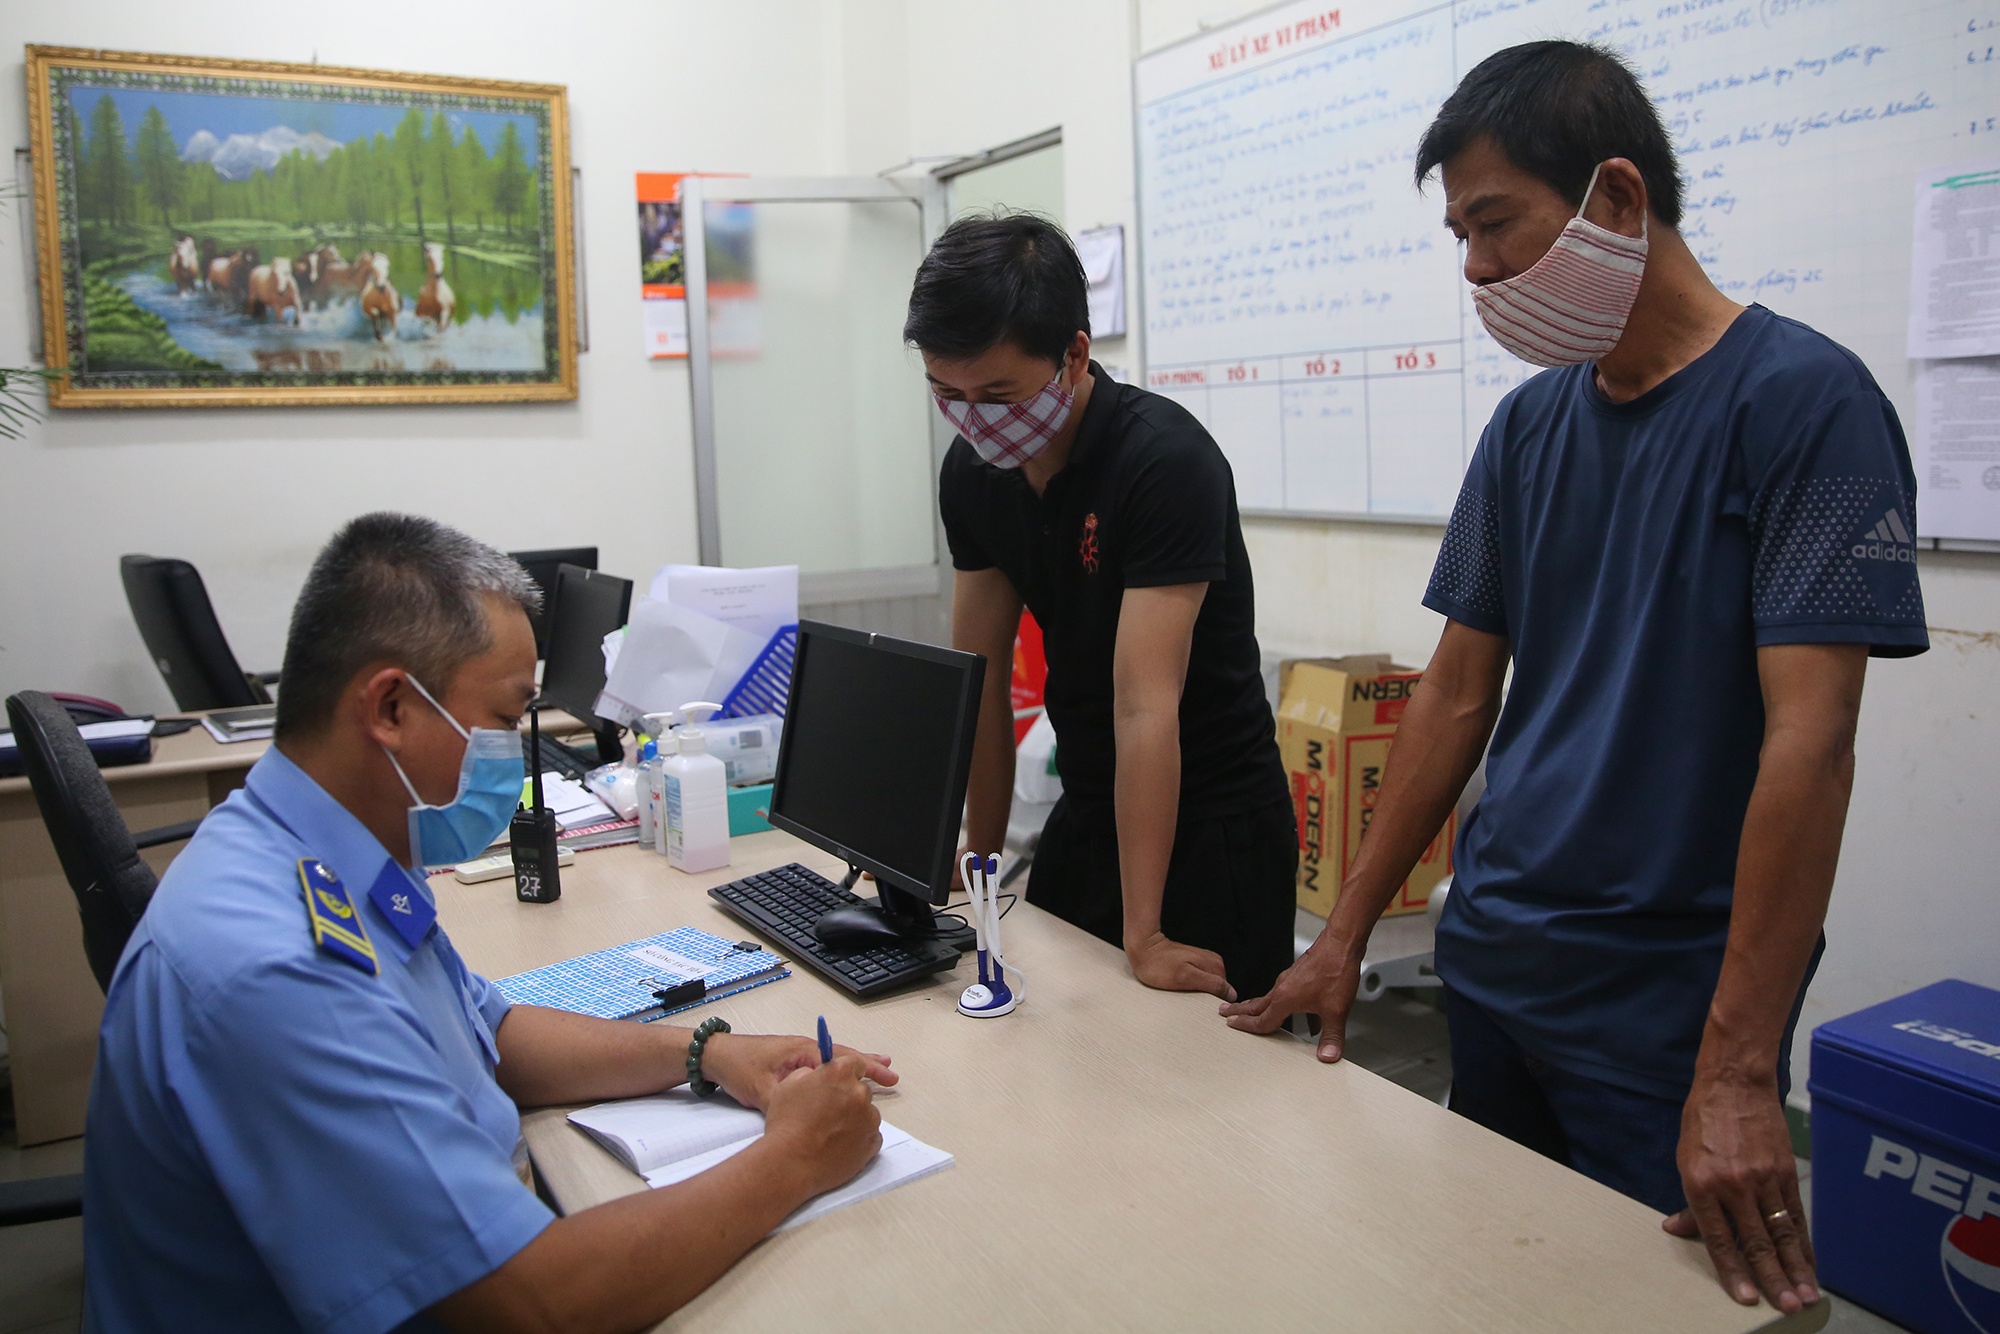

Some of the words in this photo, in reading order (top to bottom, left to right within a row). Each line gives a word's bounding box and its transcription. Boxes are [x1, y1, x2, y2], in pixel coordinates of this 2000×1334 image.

[1228, 37, 1248, 66] LÝ
[1252, 33, 1271, 56] XE
[1275, 27, 1292, 48] VI
[1295, 9, 1342, 44] PHẠM
[1305, 353, 1328, 376] TỔ
[1331, 360, 1341, 375] 2
[1394, 347, 1418, 371] TỔ
[1424, 353, 1436, 369] 3
[1227, 360, 1248, 383] TỔ
[1252, 366, 1259, 382] 1
[1852, 543, 1916, 562] adidas
[1360, 766, 1380, 842] MOD
[1304, 740, 1323, 892] MODERN
[520, 875, 541, 897] 27
